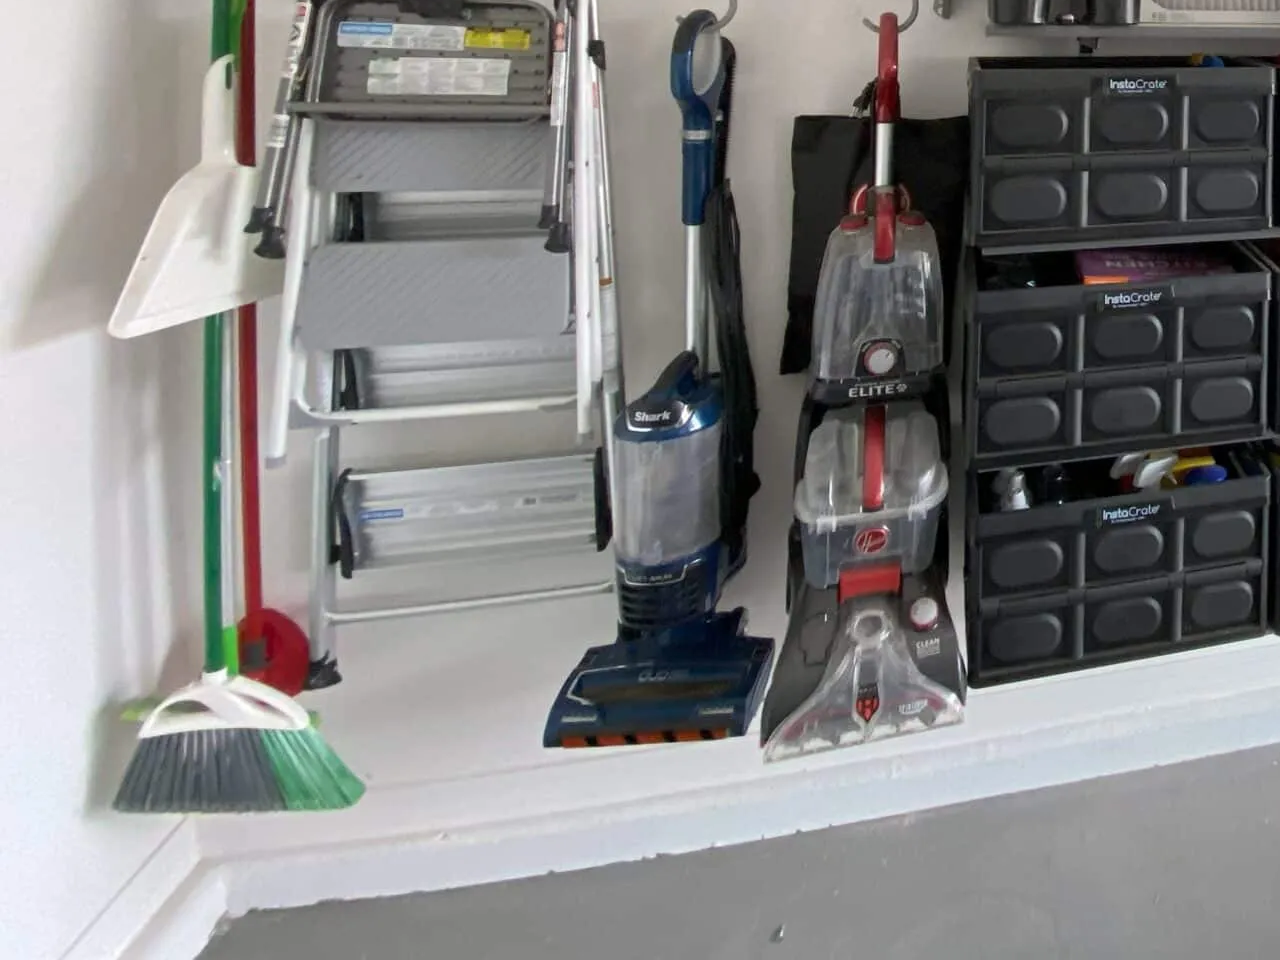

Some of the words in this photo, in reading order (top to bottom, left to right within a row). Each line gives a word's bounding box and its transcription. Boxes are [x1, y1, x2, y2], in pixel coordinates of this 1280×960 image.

[1110, 78, 1167, 89] InstaCrate
[1104, 292, 1162, 305] InstaCrate
[848, 384, 895, 398] ELITE
[634, 410, 671, 422] Shark
[1103, 504, 1160, 520] InstaCrate
[916, 638, 940, 649] CLEAN
